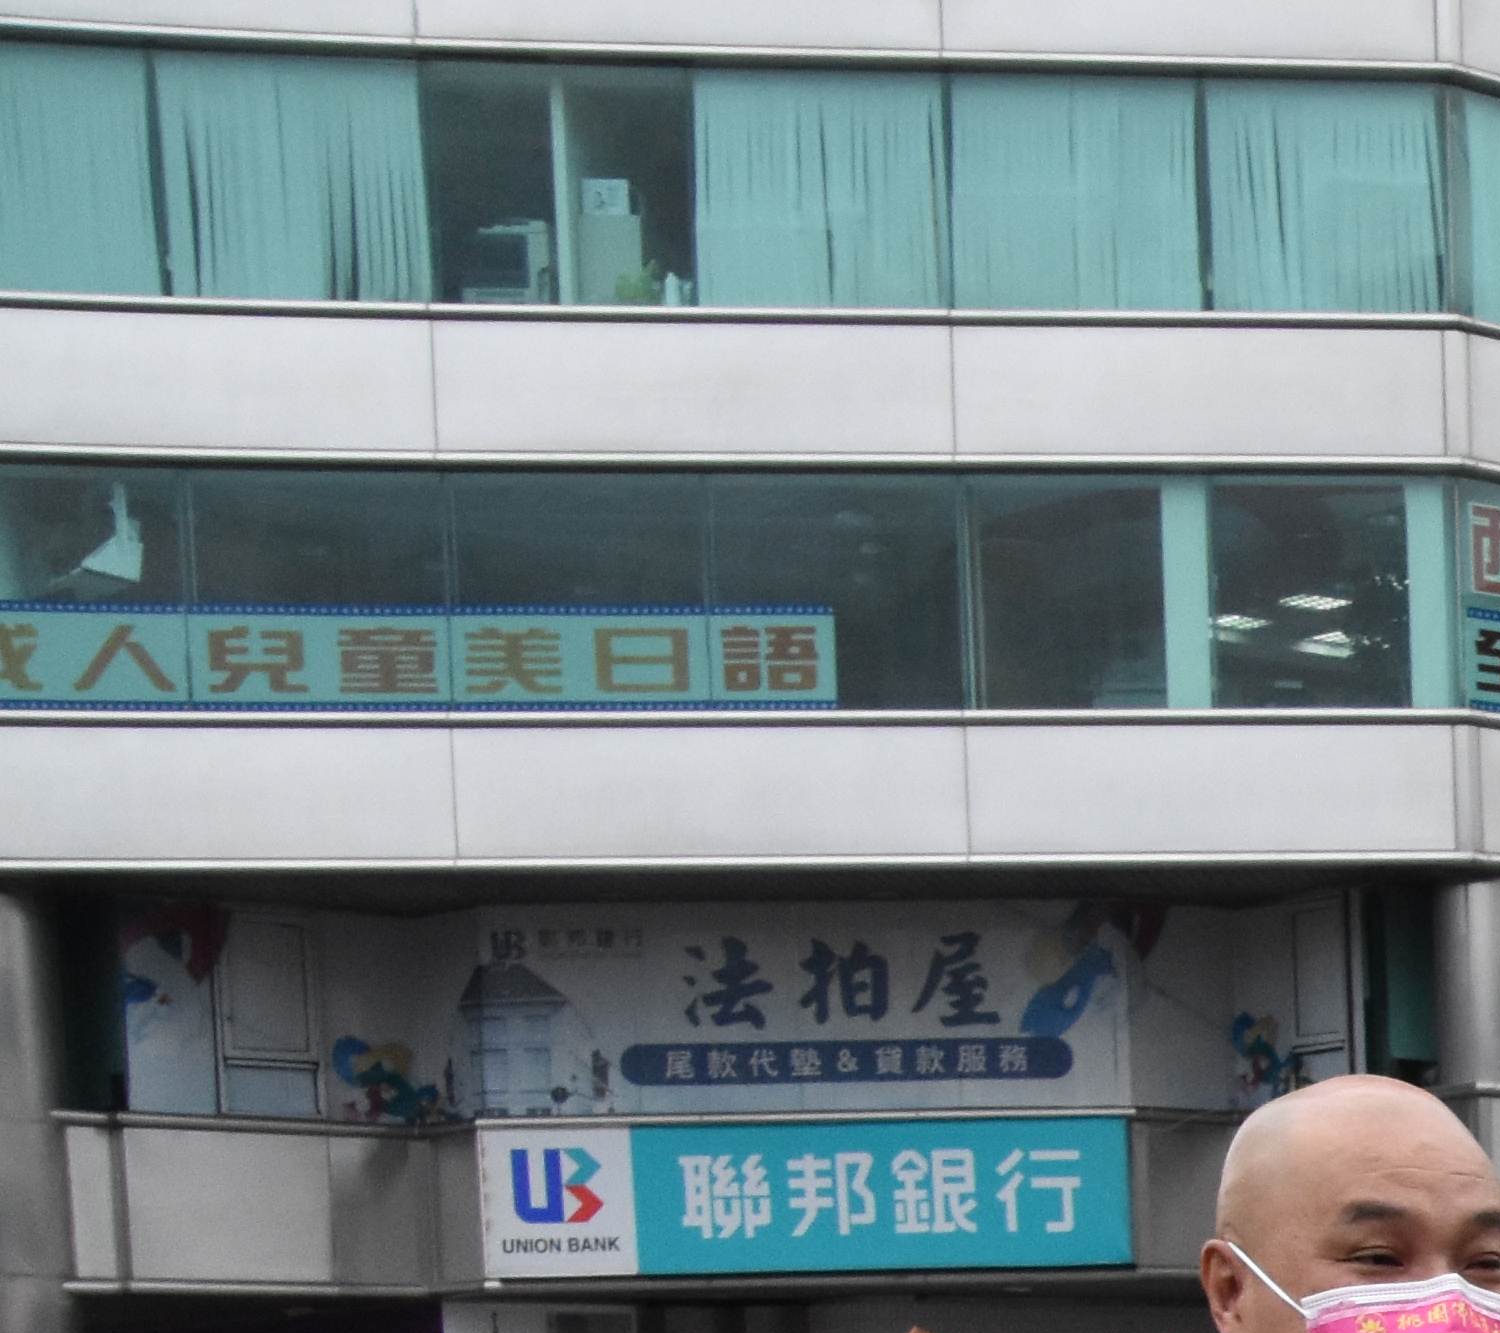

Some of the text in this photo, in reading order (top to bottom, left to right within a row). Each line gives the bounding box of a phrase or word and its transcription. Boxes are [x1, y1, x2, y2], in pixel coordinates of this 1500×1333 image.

[682, 931, 1001, 1030] 法拍屋
[678, 1149, 1081, 1239] 聯邦銀行
[502, 1236, 620, 1254] UNION BANK
